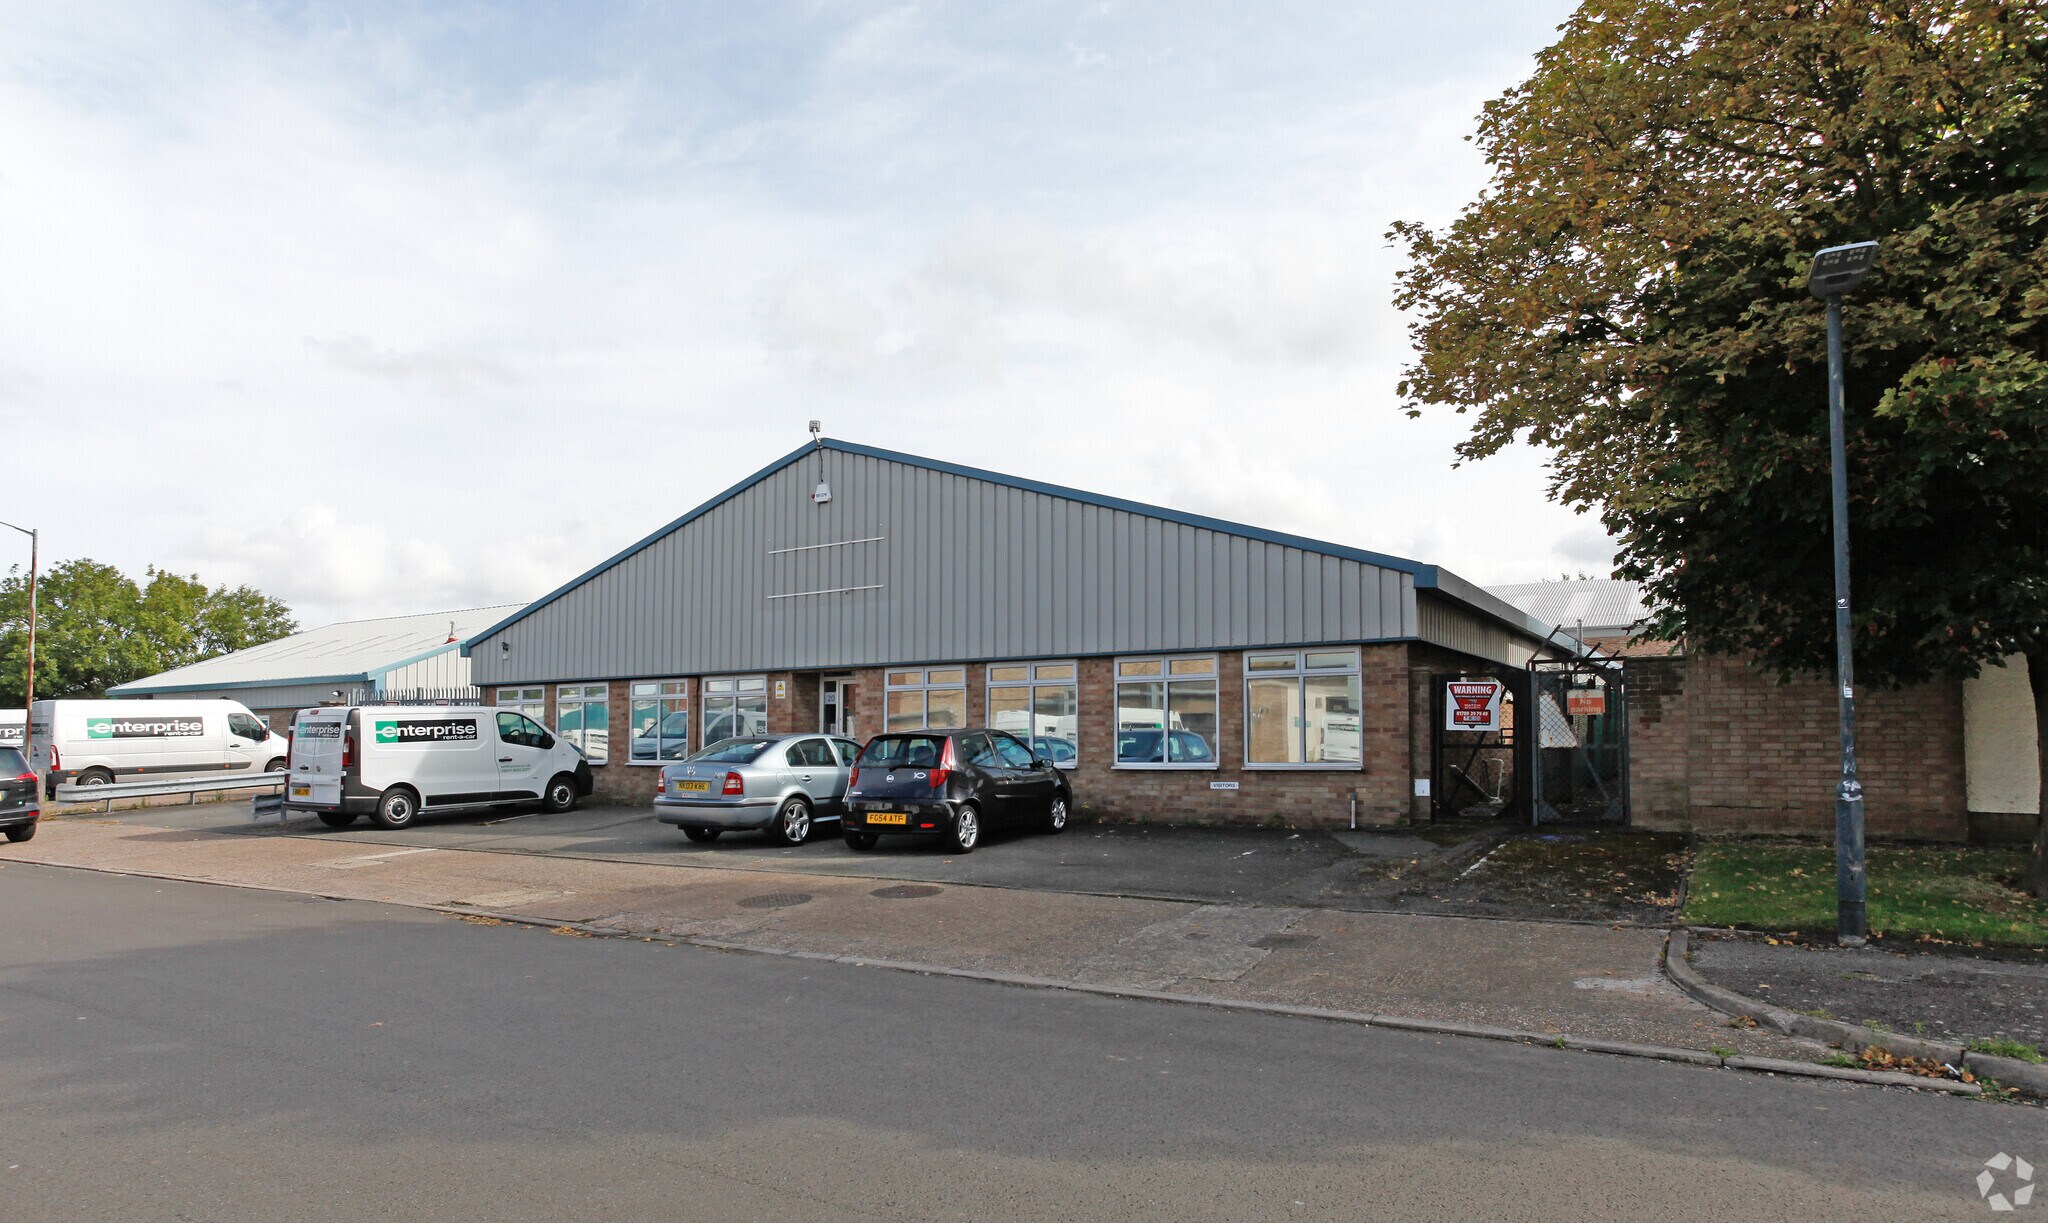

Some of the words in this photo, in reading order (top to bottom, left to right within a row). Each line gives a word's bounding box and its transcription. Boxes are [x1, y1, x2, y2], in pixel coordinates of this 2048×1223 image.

[1454, 686, 1492, 694] WARNING
[90, 720, 203, 735] enterprise
[300, 725, 340, 736] enterprise
[377, 723, 476, 739] enterprise
[870, 814, 887, 822] FG54
